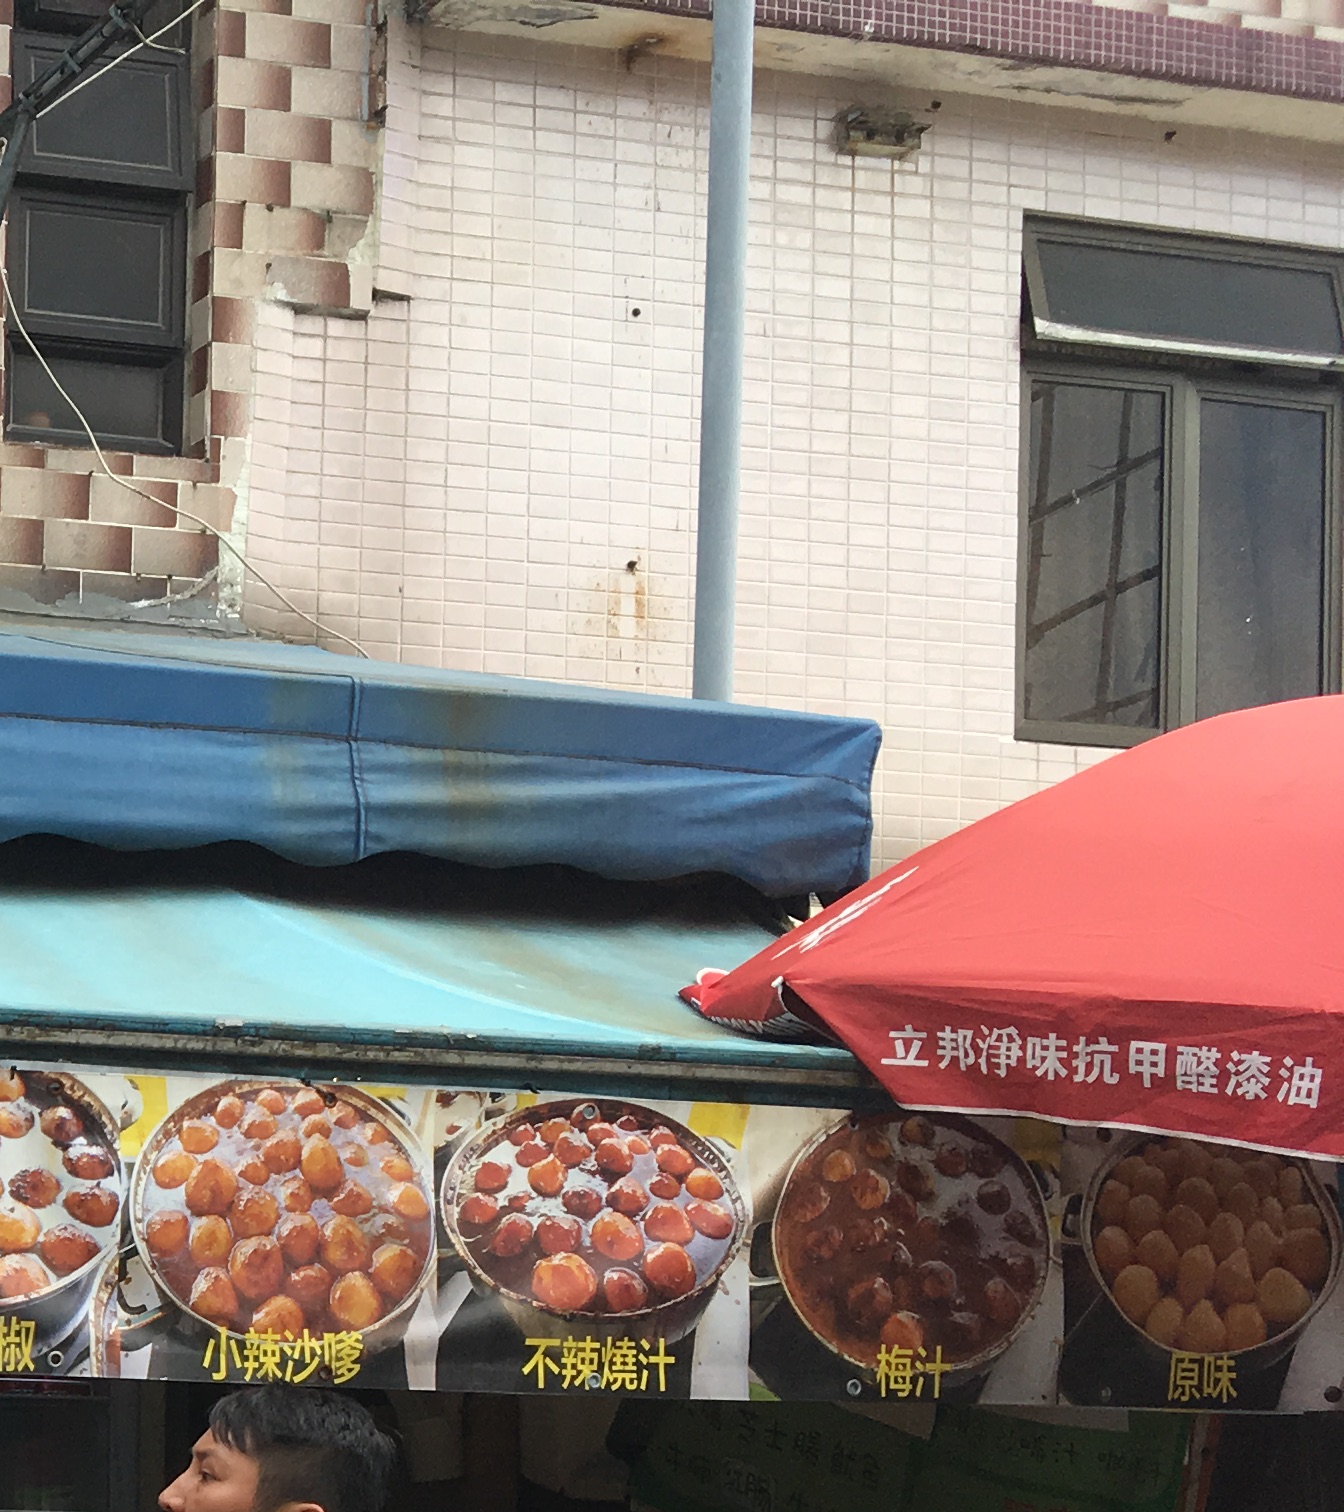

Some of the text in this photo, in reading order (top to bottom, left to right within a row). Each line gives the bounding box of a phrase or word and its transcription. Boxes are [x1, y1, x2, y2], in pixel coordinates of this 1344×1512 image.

[880, 1023, 1325, 1110] 立邦淨味抗甲醛漆油
[201, 1325, 364, 1386] 小辣沙嗲
[521, 1335, 676, 1394] 不辣燒汁
[875, 1343, 953, 1400] 梅汁
[1166, 1353, 1239, 1405] 原味
